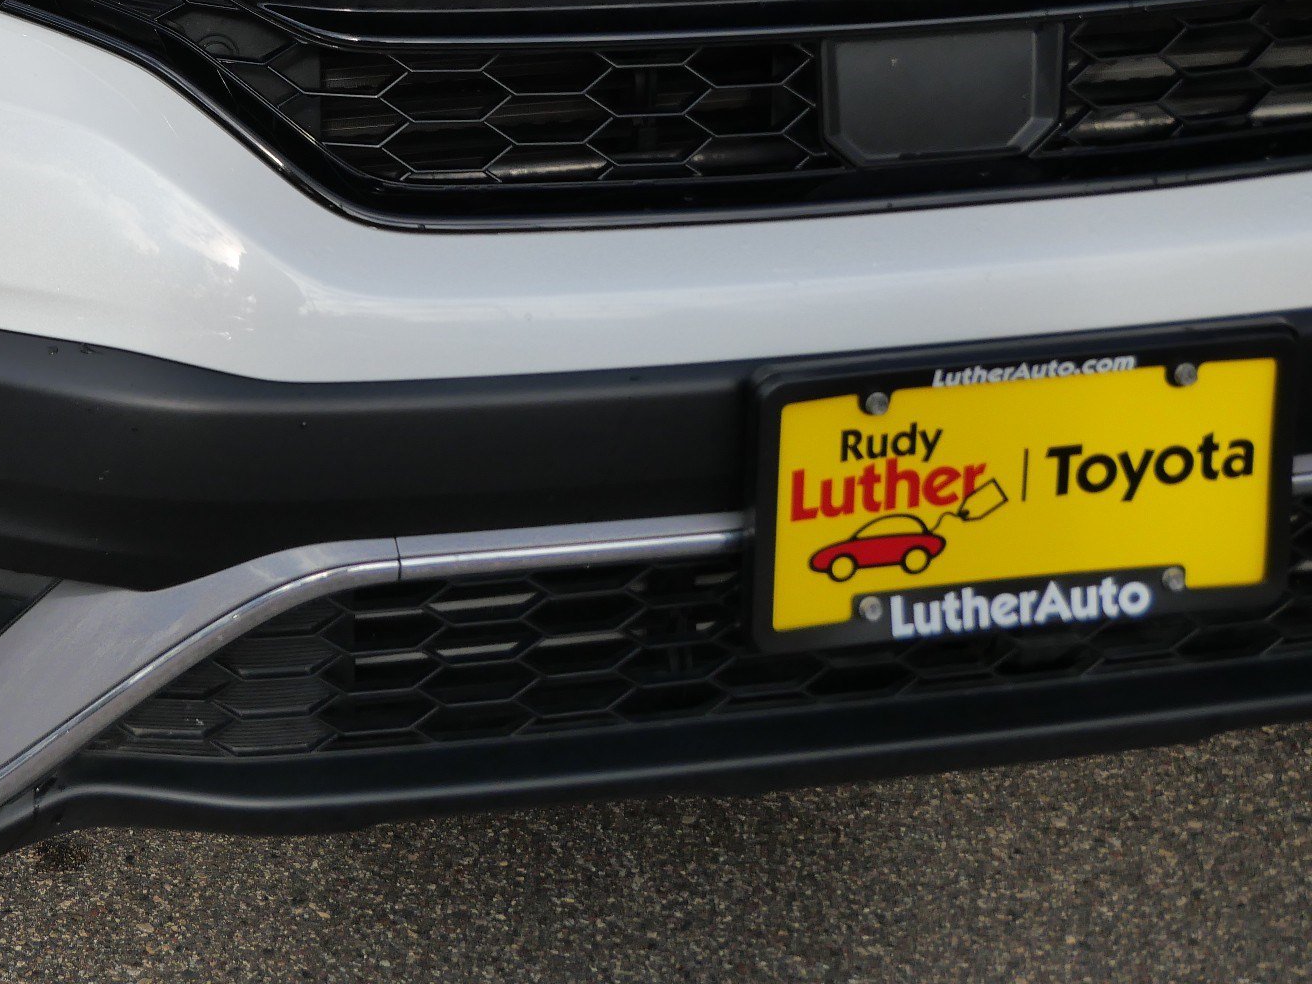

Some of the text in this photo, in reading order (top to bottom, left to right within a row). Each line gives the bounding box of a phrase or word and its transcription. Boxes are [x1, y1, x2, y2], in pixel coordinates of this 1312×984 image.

[931, 354, 1136, 389] LutherAuto.com
[840, 421, 944, 463] Rudy
[1045, 432, 1256, 503] Toyota
[790, 457, 987, 523] Luther
[889, 576, 1152, 639] LutherAuto
